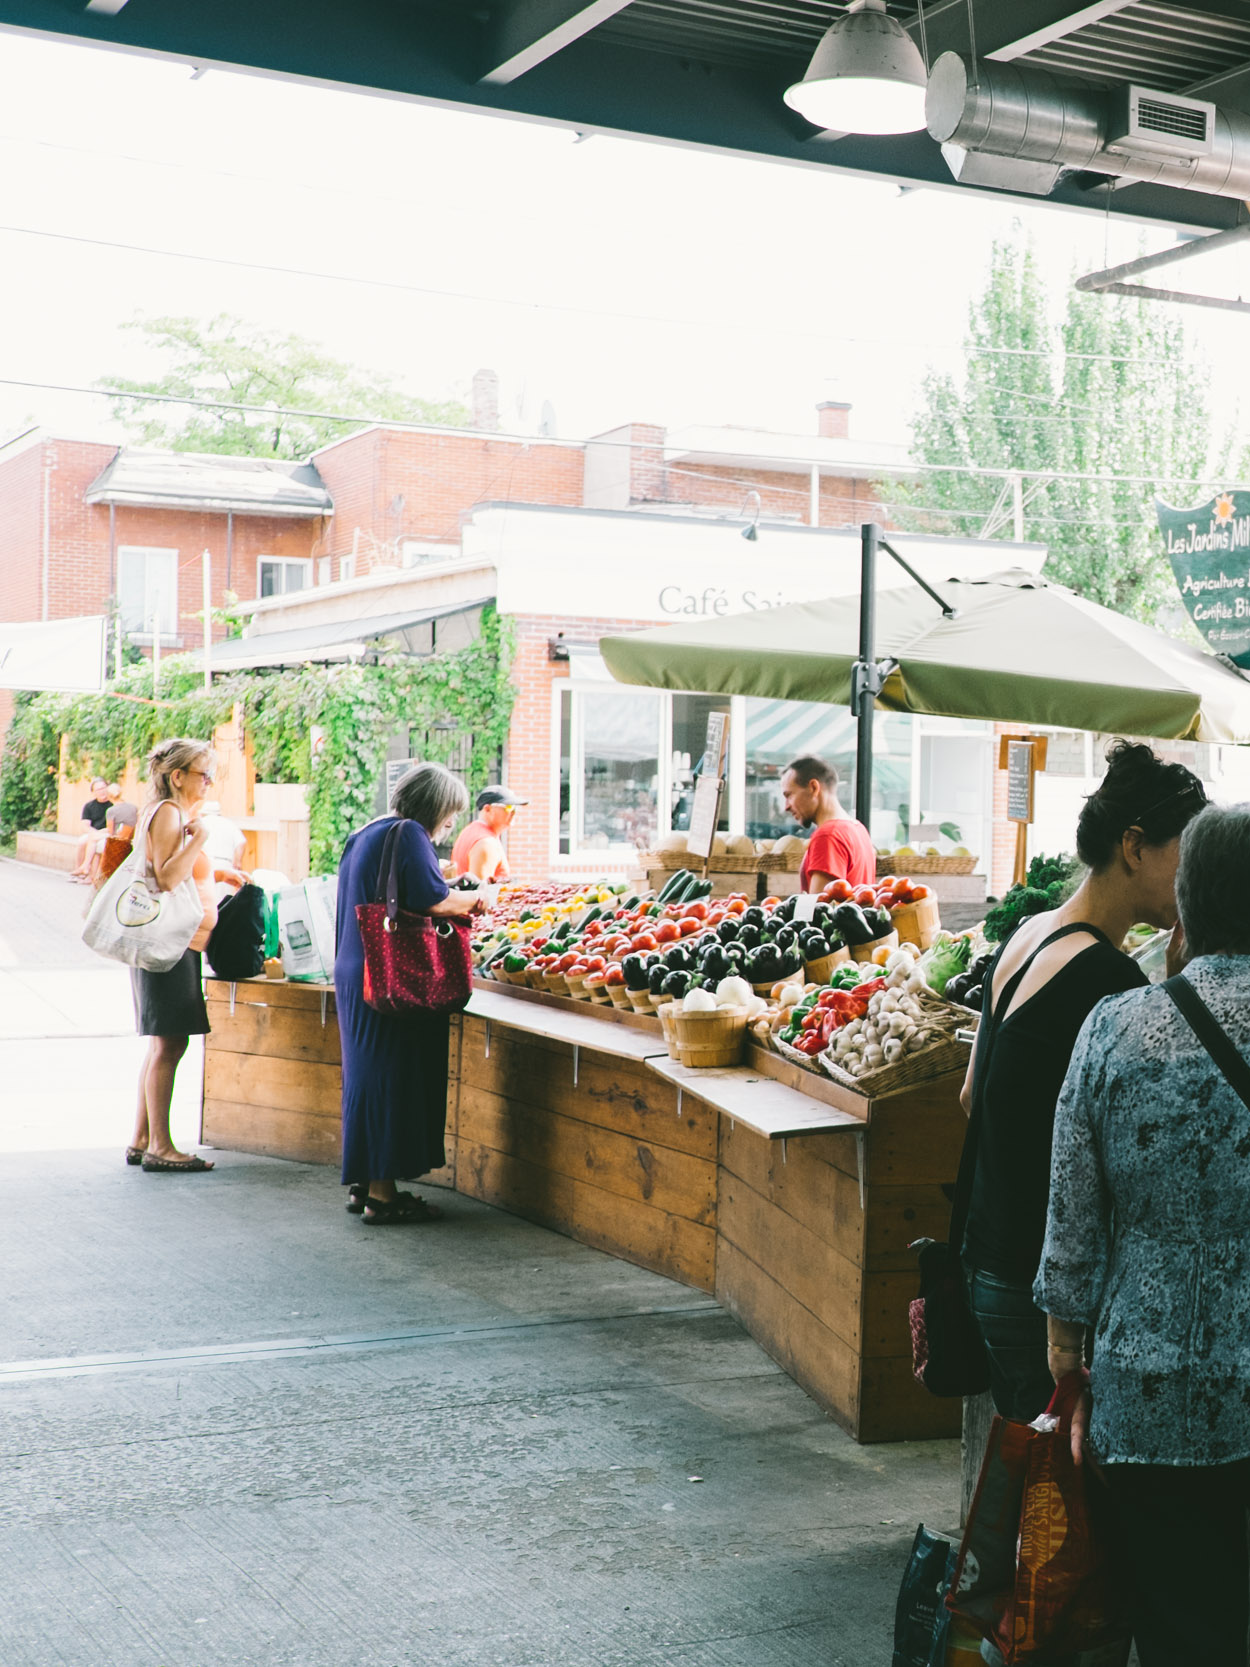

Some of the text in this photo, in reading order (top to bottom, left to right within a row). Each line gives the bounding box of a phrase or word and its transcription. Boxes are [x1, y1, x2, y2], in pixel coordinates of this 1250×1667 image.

[1168, 529, 1185, 554] Les
[1186, 519, 1229, 554] Jardins
[1182, 571, 1245, 597] Agriculture
[658, 585, 729, 616] Café
